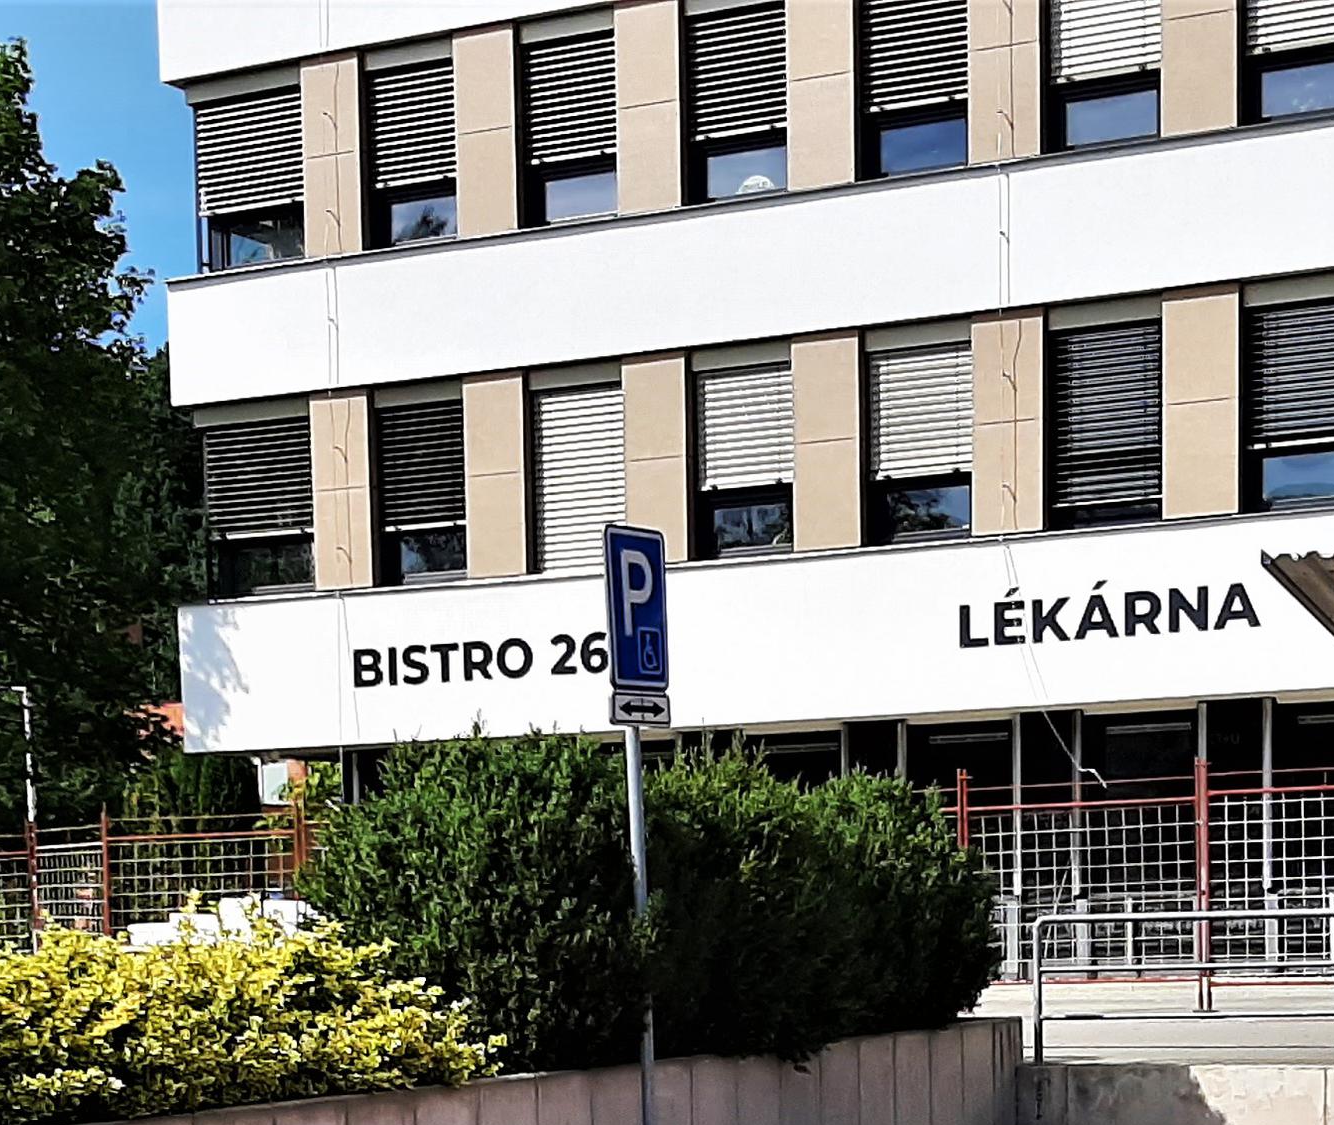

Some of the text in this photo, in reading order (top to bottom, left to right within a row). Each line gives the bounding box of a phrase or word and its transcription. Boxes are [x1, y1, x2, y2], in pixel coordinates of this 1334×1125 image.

[620, 548, 653, 637] P
[958, 579, 1262, 649] LÉKÁRNA
[352, 631, 609, 688] BISTRO 26
